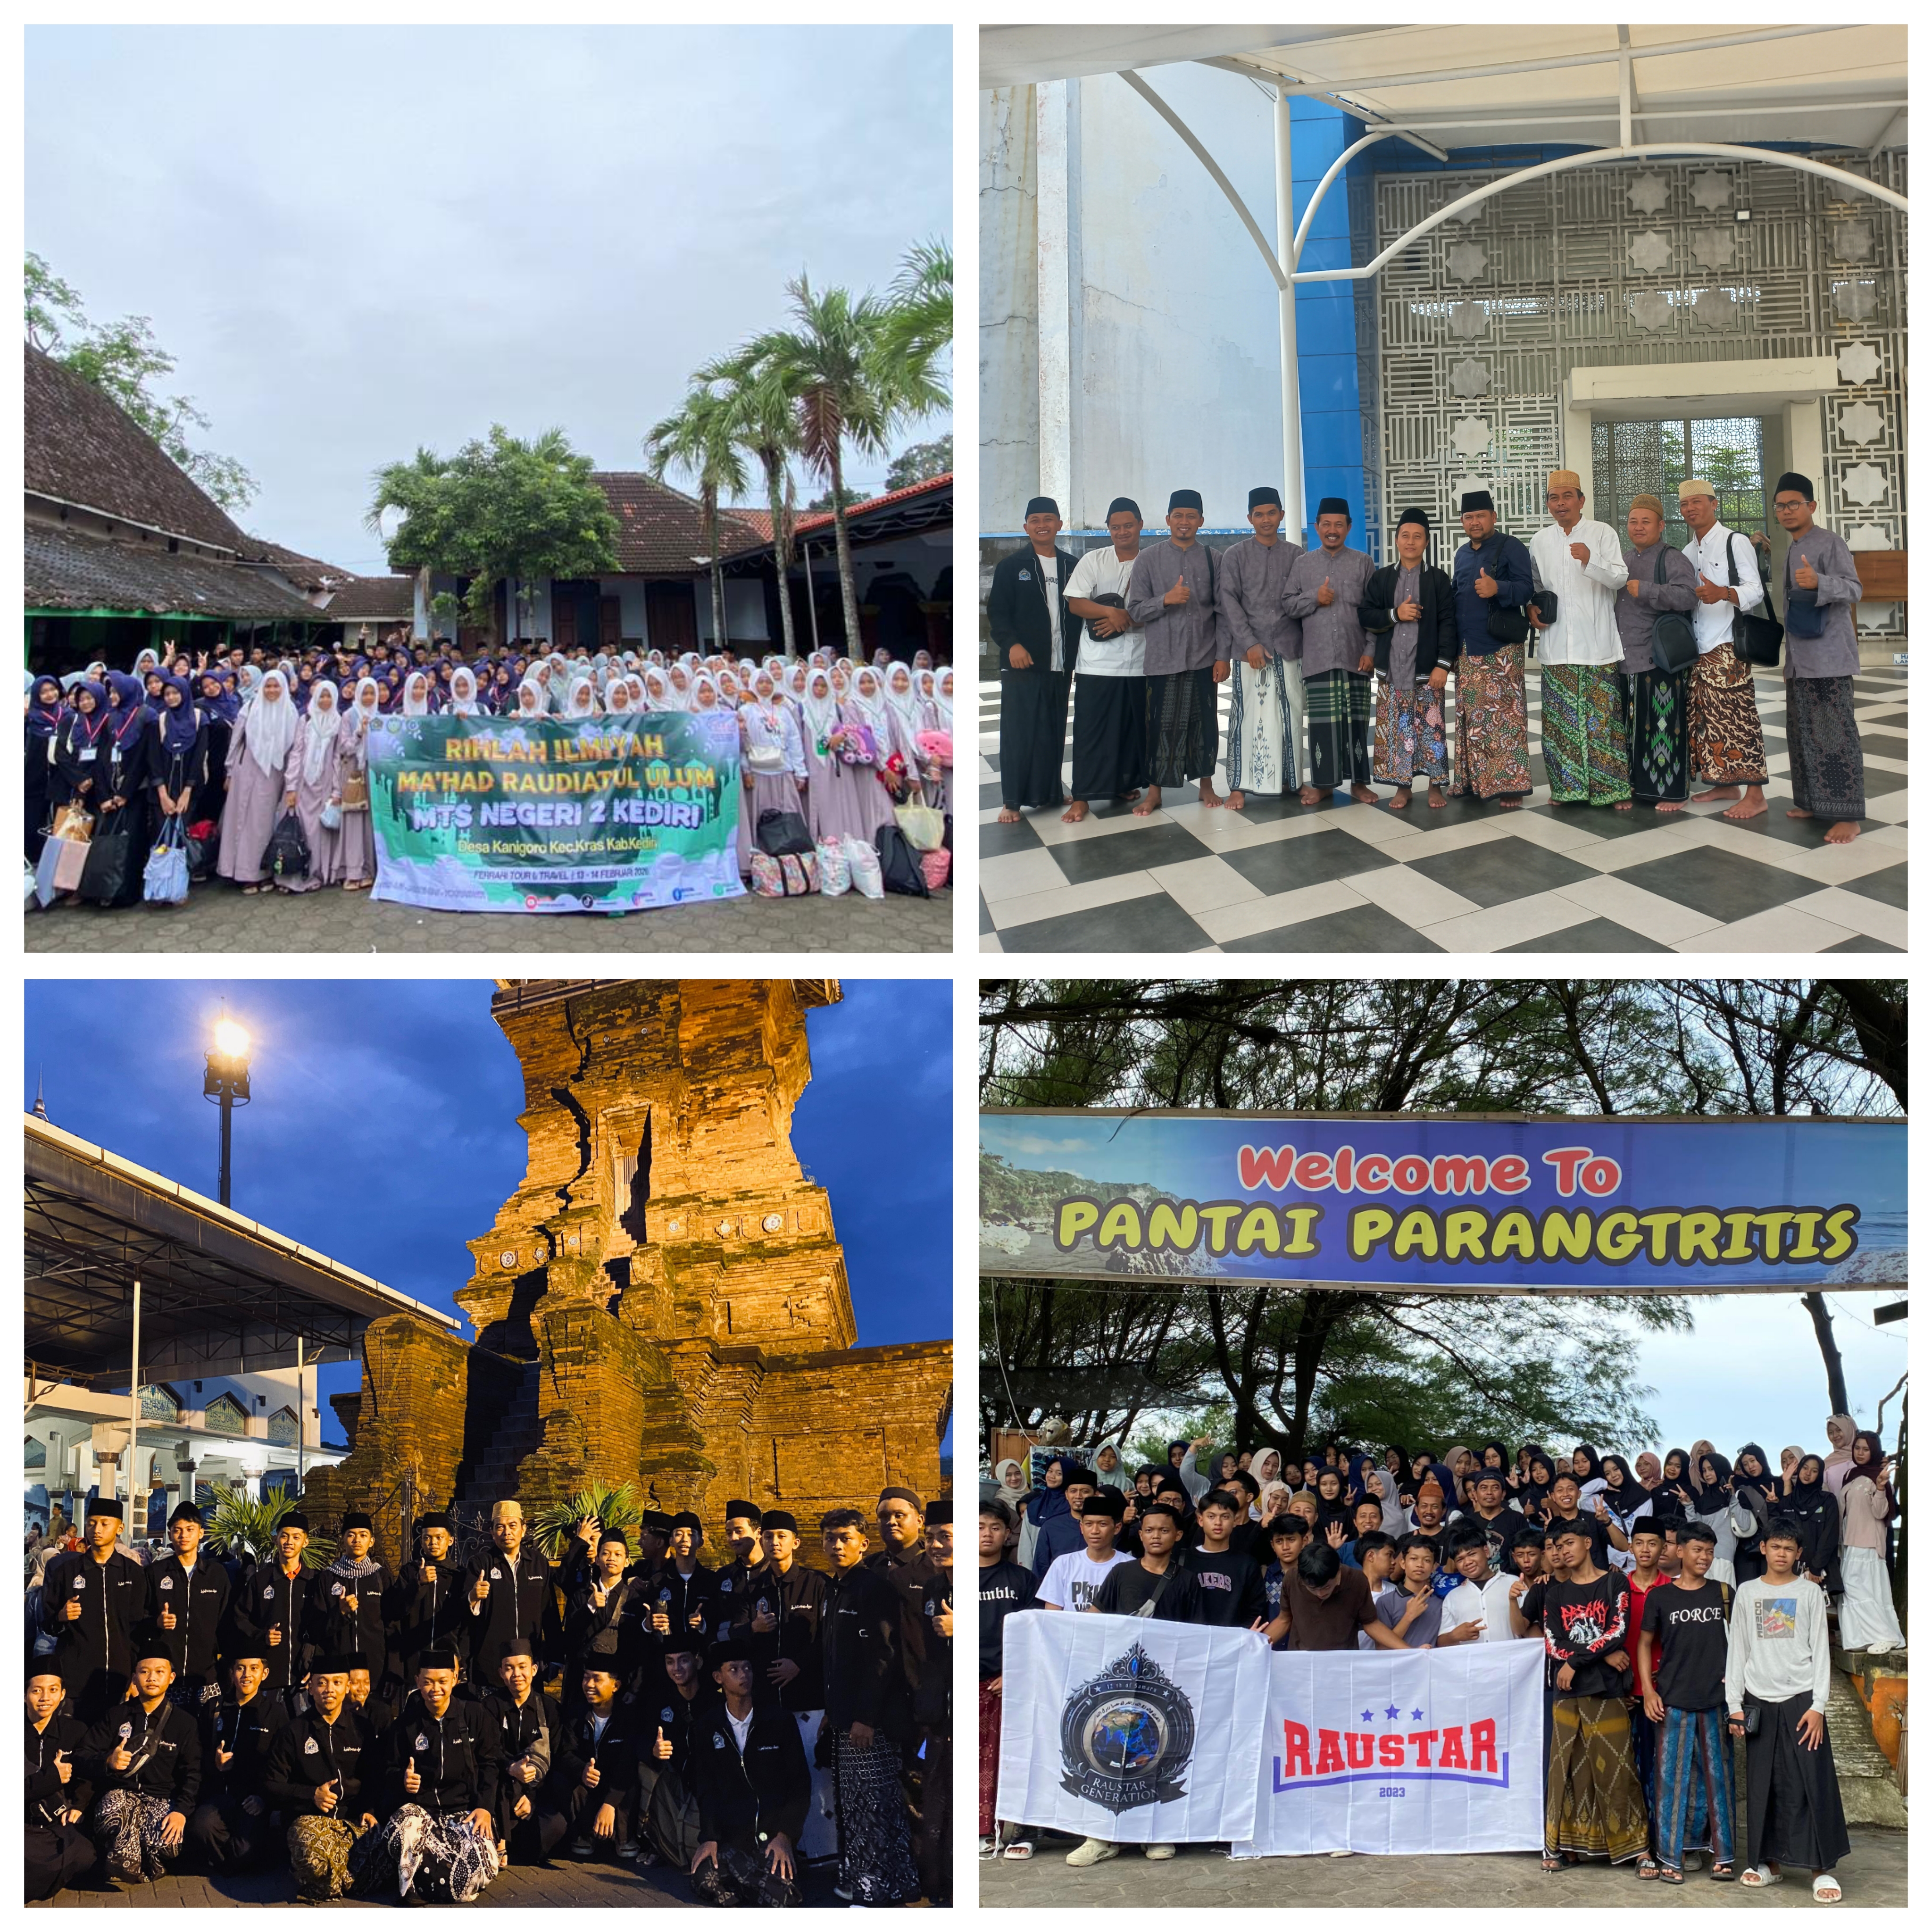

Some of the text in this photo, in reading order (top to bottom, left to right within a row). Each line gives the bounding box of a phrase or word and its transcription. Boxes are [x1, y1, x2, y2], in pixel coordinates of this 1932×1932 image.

[446, 734, 664, 763] RIHLAH ILMIYAH
[397, 766, 716, 793] MA'HAD RAUDIATUL ULUM
[413, 798, 705, 830] MTS NEGERI 2 KEDIRI
[458, 840, 489, 854] Desa
[493, 841, 547, 858] Kanigoro
[510, 871, 531, 880] TOUR
[539, 870, 569, 880] TRAVEL
[1238, 1144, 1622, 1197] Welcome To
[1055, 1195, 1861, 1266] PANTAI PARANGTRITIS
[1670, 1607, 1721, 1624] FORCE
[1283, 1717, 1498, 1778] RAUSTAR
[1081, 1784, 1159, 1803] GENERATION
[1092, 1777, 1148, 1792] RAUSTAR
[1379, 1787, 1406, 1798] 2023
